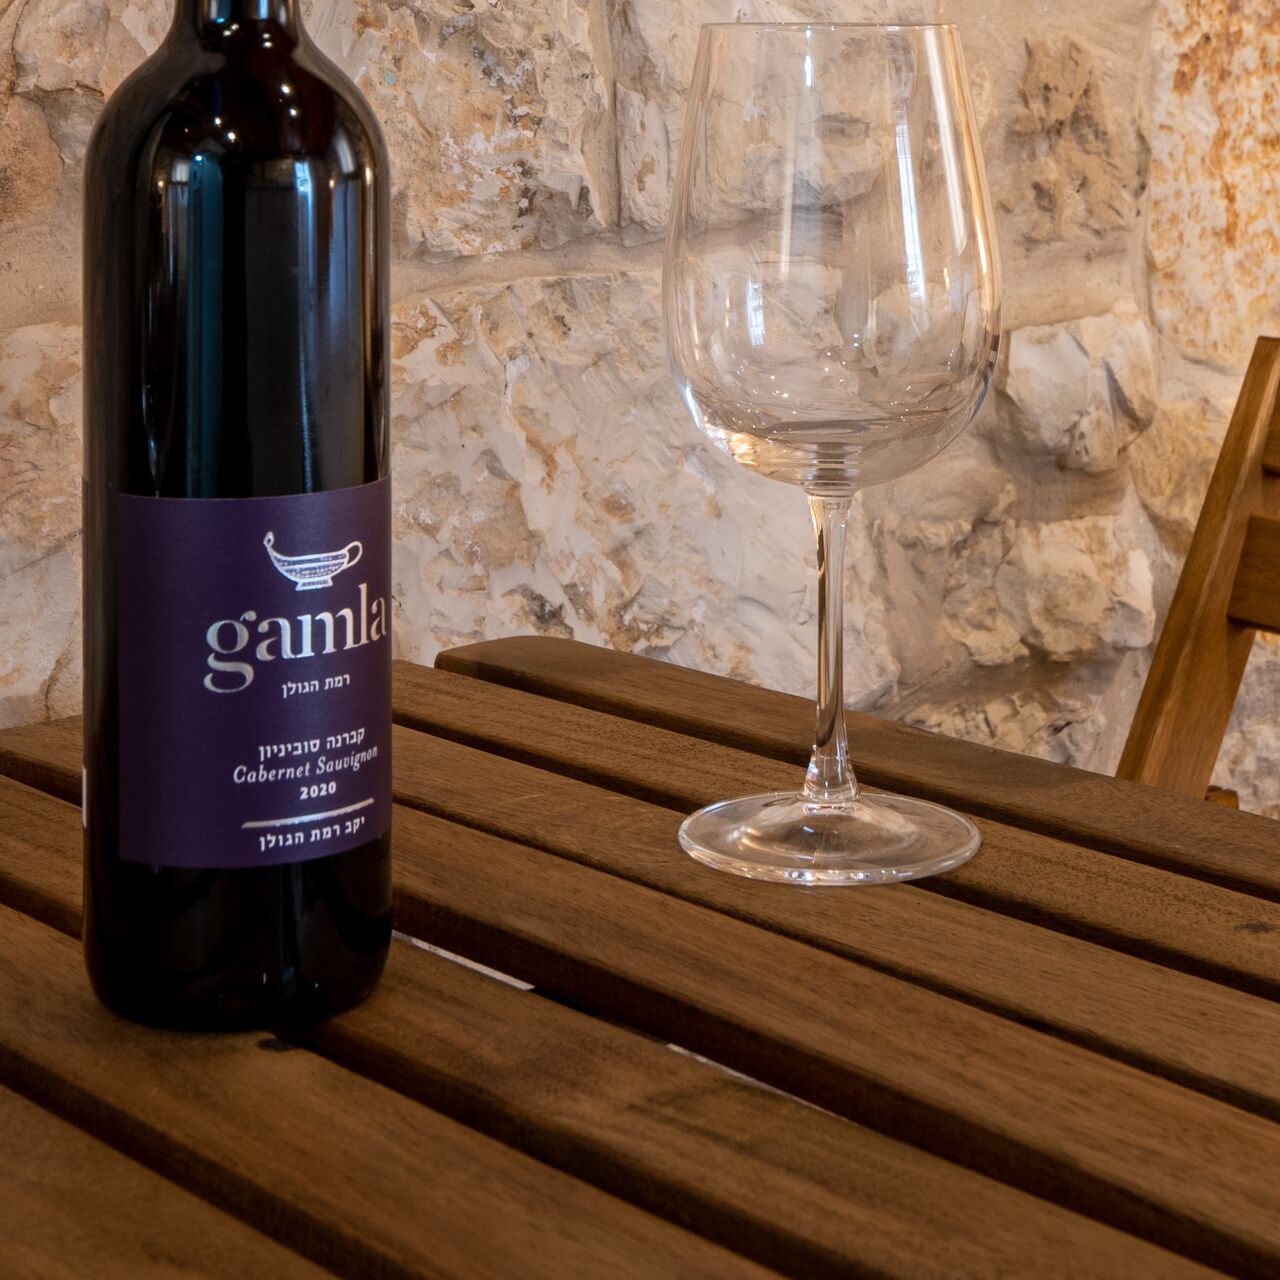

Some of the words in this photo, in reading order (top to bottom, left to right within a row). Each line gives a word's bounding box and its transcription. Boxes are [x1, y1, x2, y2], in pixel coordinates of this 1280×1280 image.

[203, 583, 387, 694] gamla
[281, 679, 320, 699] הגולן
[323, 673, 351, 691] רמת
[325, 727, 366, 751] קברנה
[258, 738, 321, 762] סוביניון
[232, 762, 312, 784] Cabernet
[315, 745, 378, 775] Sauvignon
[299, 780, 337, 800] 2020
[309, 823, 341, 843] רמת
[344, 815, 366, 835] יקב
[258, 831, 305, 852] הגולן
